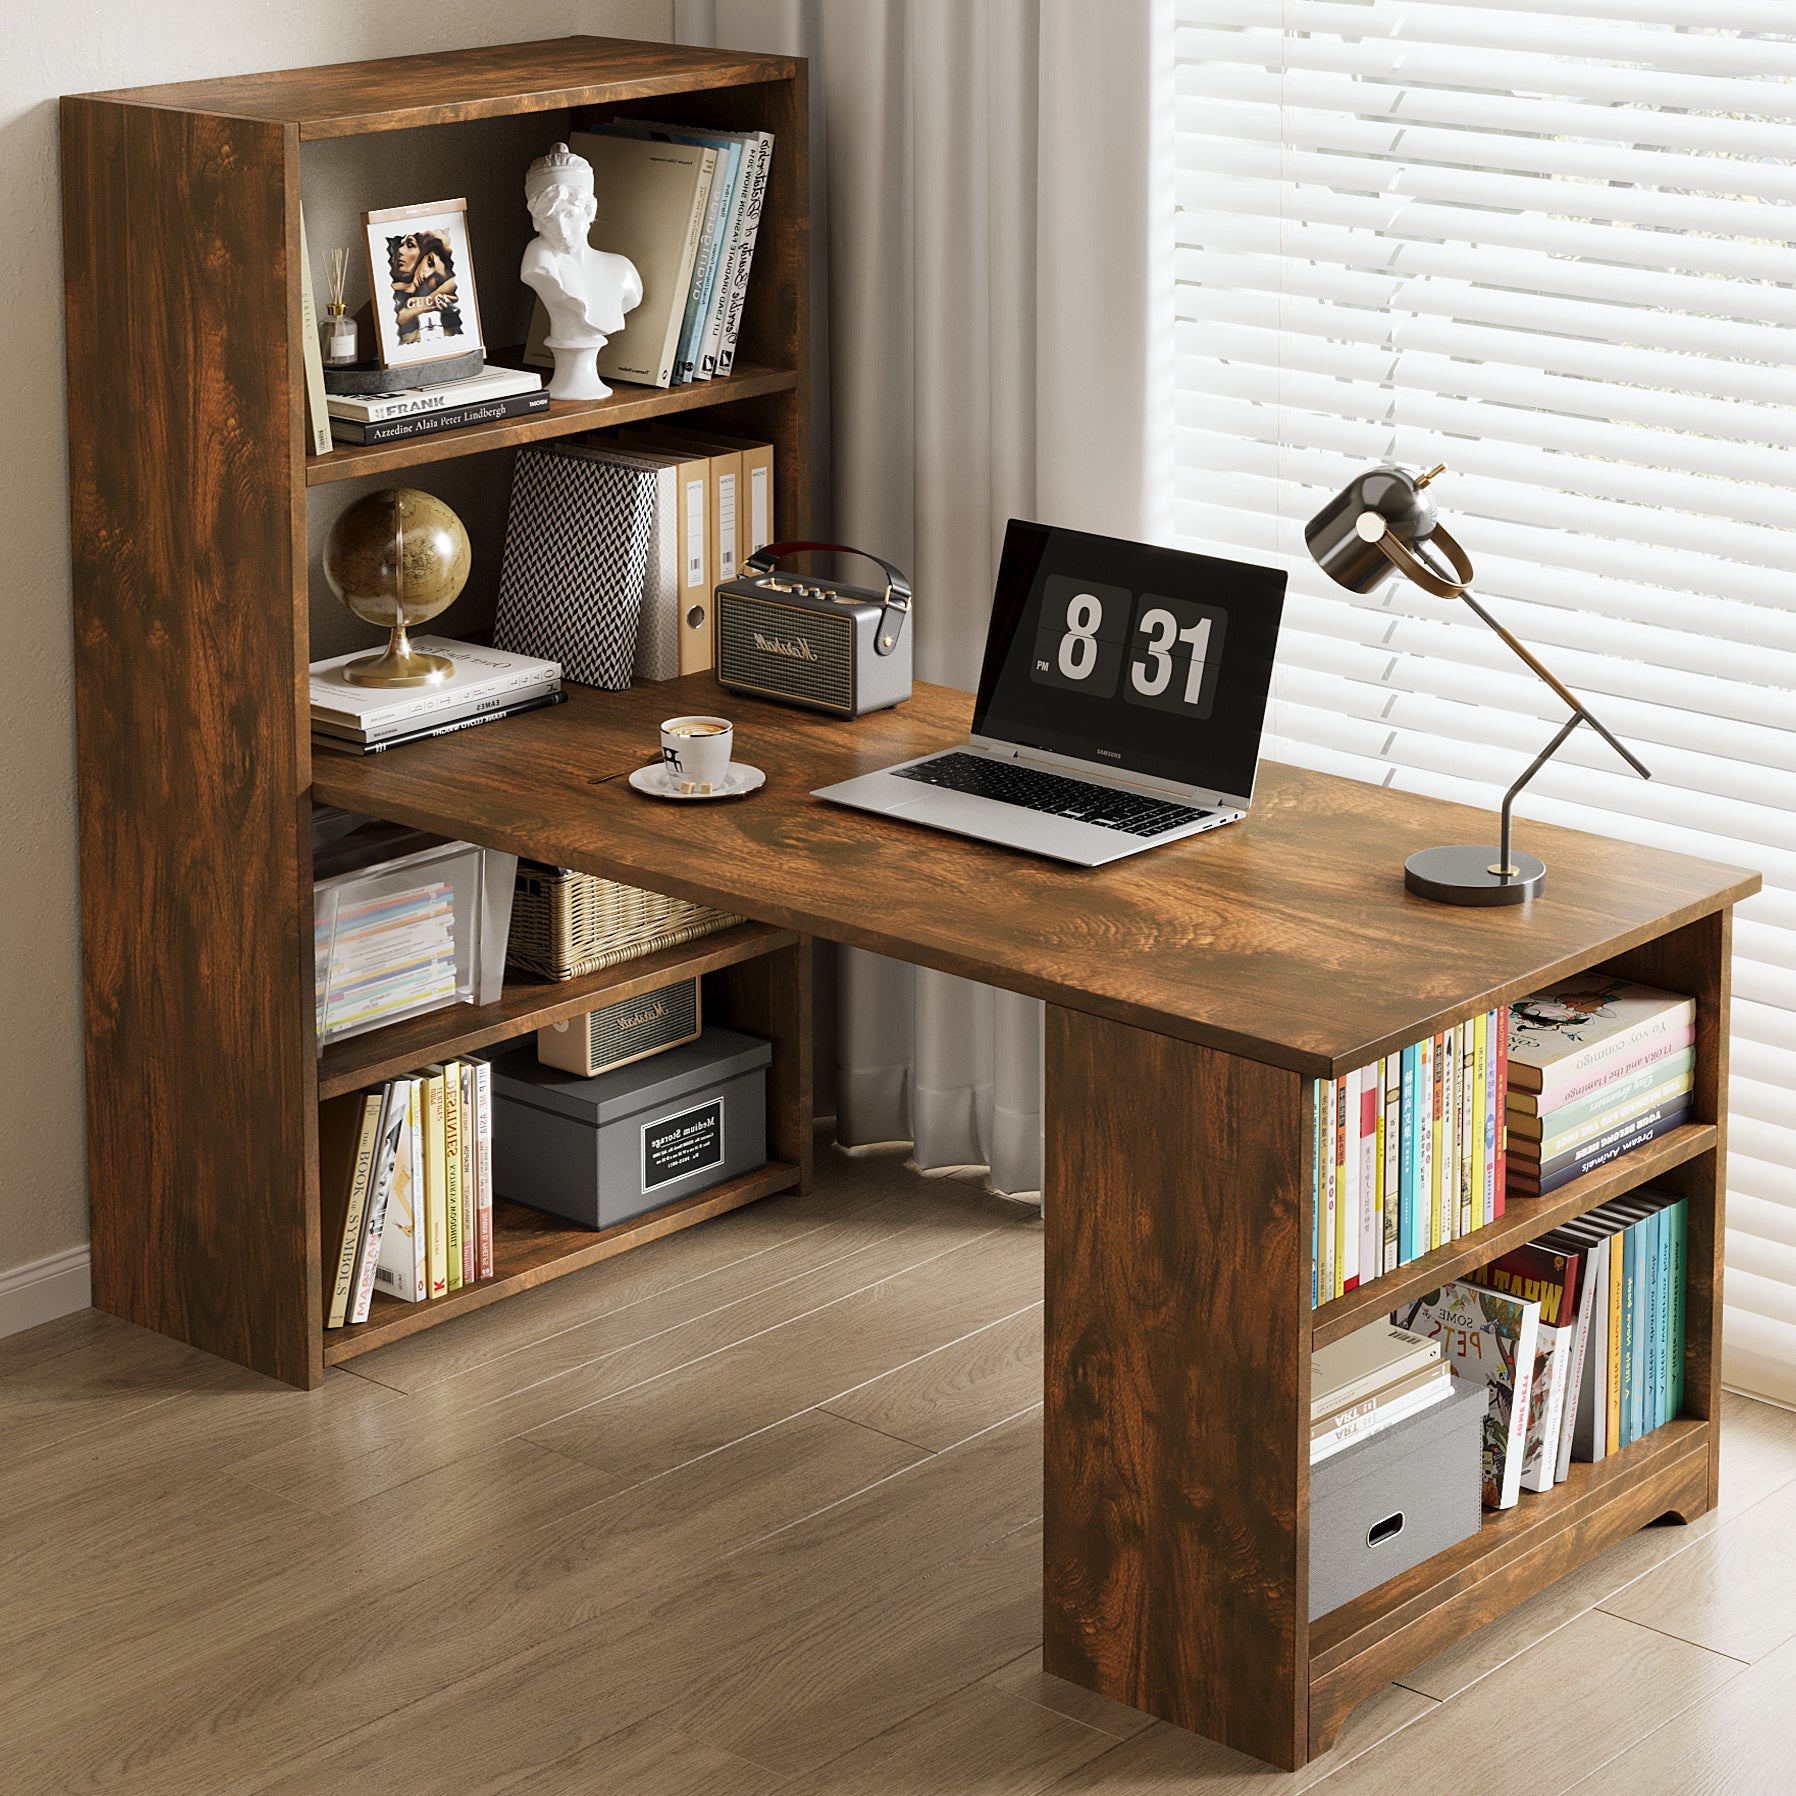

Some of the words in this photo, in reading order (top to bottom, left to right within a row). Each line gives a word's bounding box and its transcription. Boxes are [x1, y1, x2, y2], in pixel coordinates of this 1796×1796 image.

[386, 396, 446, 417] FRANK
[529, 398, 548, 408] TASCHEN
[374, 422, 413, 440] Azzedine
[416, 417, 438, 431] Alaïa
[440, 415, 462, 427] Peter
[464, 405, 507, 423] Lindbergh
[1058, 593, 1103, 680] 8
[1131, 608, 1212, 705] 31
[1036, 660, 1050, 672] PM
[1096, 748, 1122, 760] SAMSUNG
[1630, 1031, 1649, 1045] voy
[1652, 1022, 1667, 1034] Yo
[1576, 1040, 1625, 1070] conmigo
[1643, 1044, 1672, 1062] FLORA
[1609, 1066, 1624, 1079] the
[1625, 1058, 1642, 1070] and
[1565, 1072, 1608, 1101] Flamingo
[1601, 1122, 1635, 1147] BELONG
[1623, 1130, 1654, 1150] Dream
[1581, 1147, 1621, 1173] Animals
[354, 1151, 371, 1197] BOOK
[337, 1213, 360, 1297] SYMBOLS
